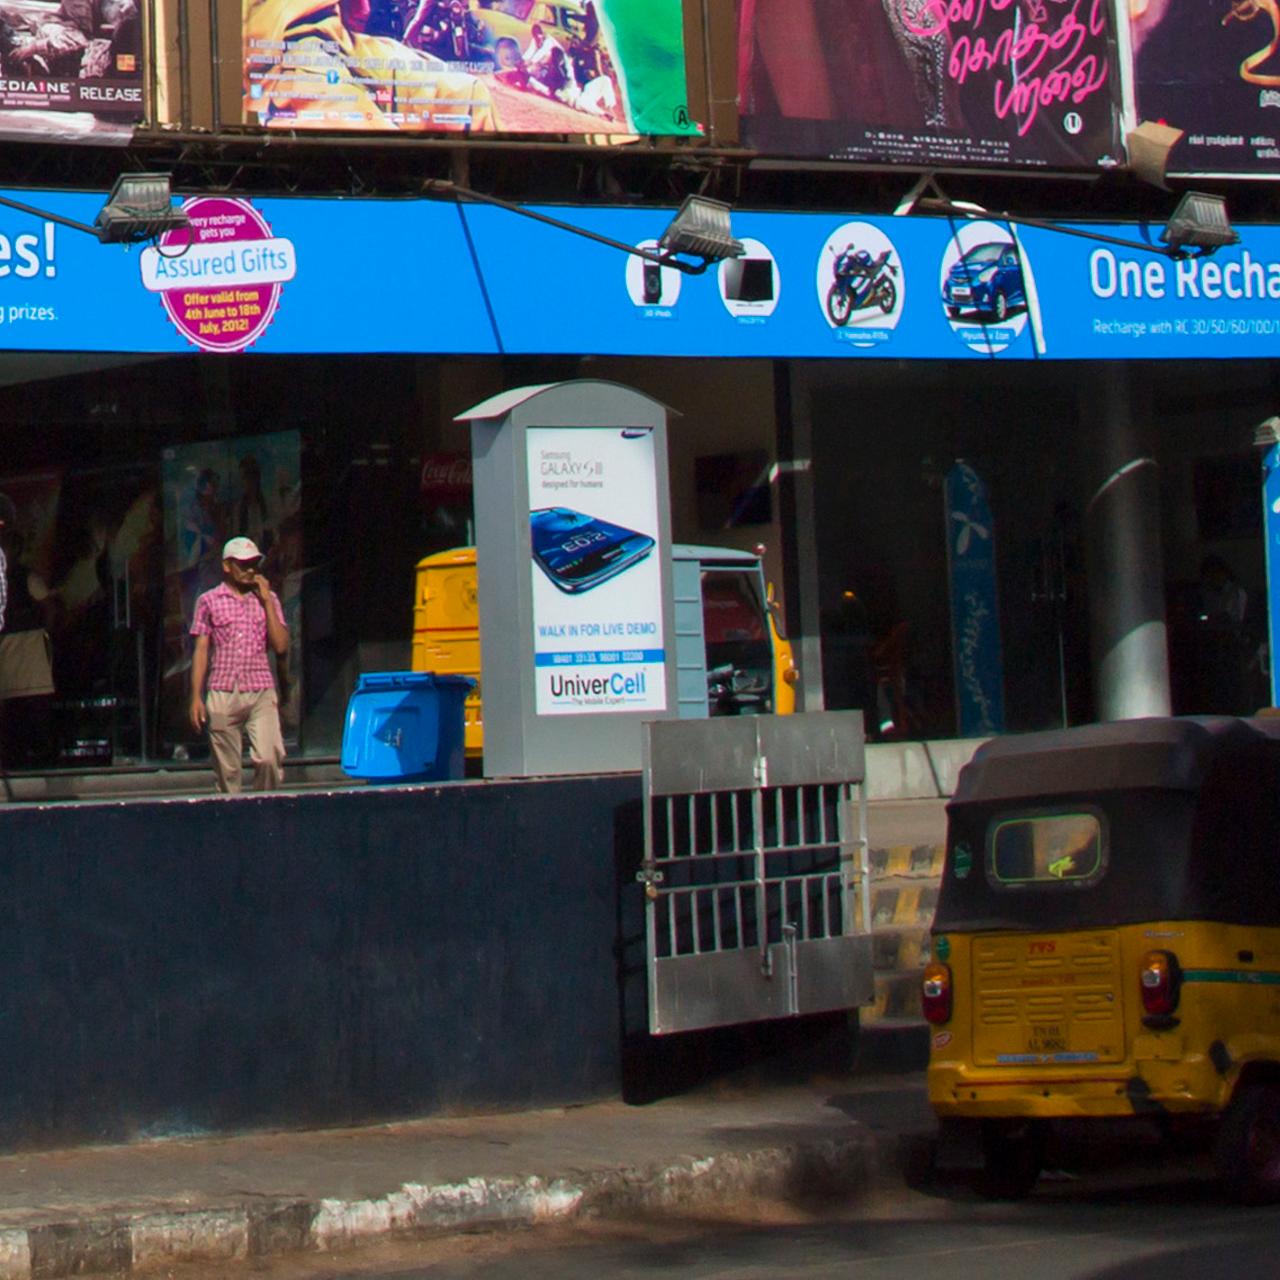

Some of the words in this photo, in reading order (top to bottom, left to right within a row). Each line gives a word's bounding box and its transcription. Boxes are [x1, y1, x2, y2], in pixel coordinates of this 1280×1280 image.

[79, 86, 143, 102] RELEASE
[208, 214, 247, 227] recharge
[199, 227, 220, 241] gets
[219, 226, 236, 239] you
[154, 249, 237, 280] Assured
[241, 247, 289, 274] Gifts
[1089, 248, 1166, 299] One
[183, 292, 210, 307] Offer
[211, 290, 235, 304] valid
[235, 289, 260, 303] from
[8, 302, 59, 326] prizes.
[184, 306, 203, 321] 4th
[203, 305, 226, 320] June
[227, 305, 238, 318] to
[238, 303, 262, 317] 18th
[199, 321, 221, 337] July,
[221, 318, 250, 333] 2012!
[1092, 318, 1147, 339] Recharge
[540, 461, 582, 477] GALAXY
[537, 623, 566, 637] WALK
[569, 623, 578, 637] IN
[580, 623, 600, 637] FOR
[602, 622, 624, 636] LIVE
[626, 621, 657, 635] DEMO
[550, 670, 646, 697] UniverCell
